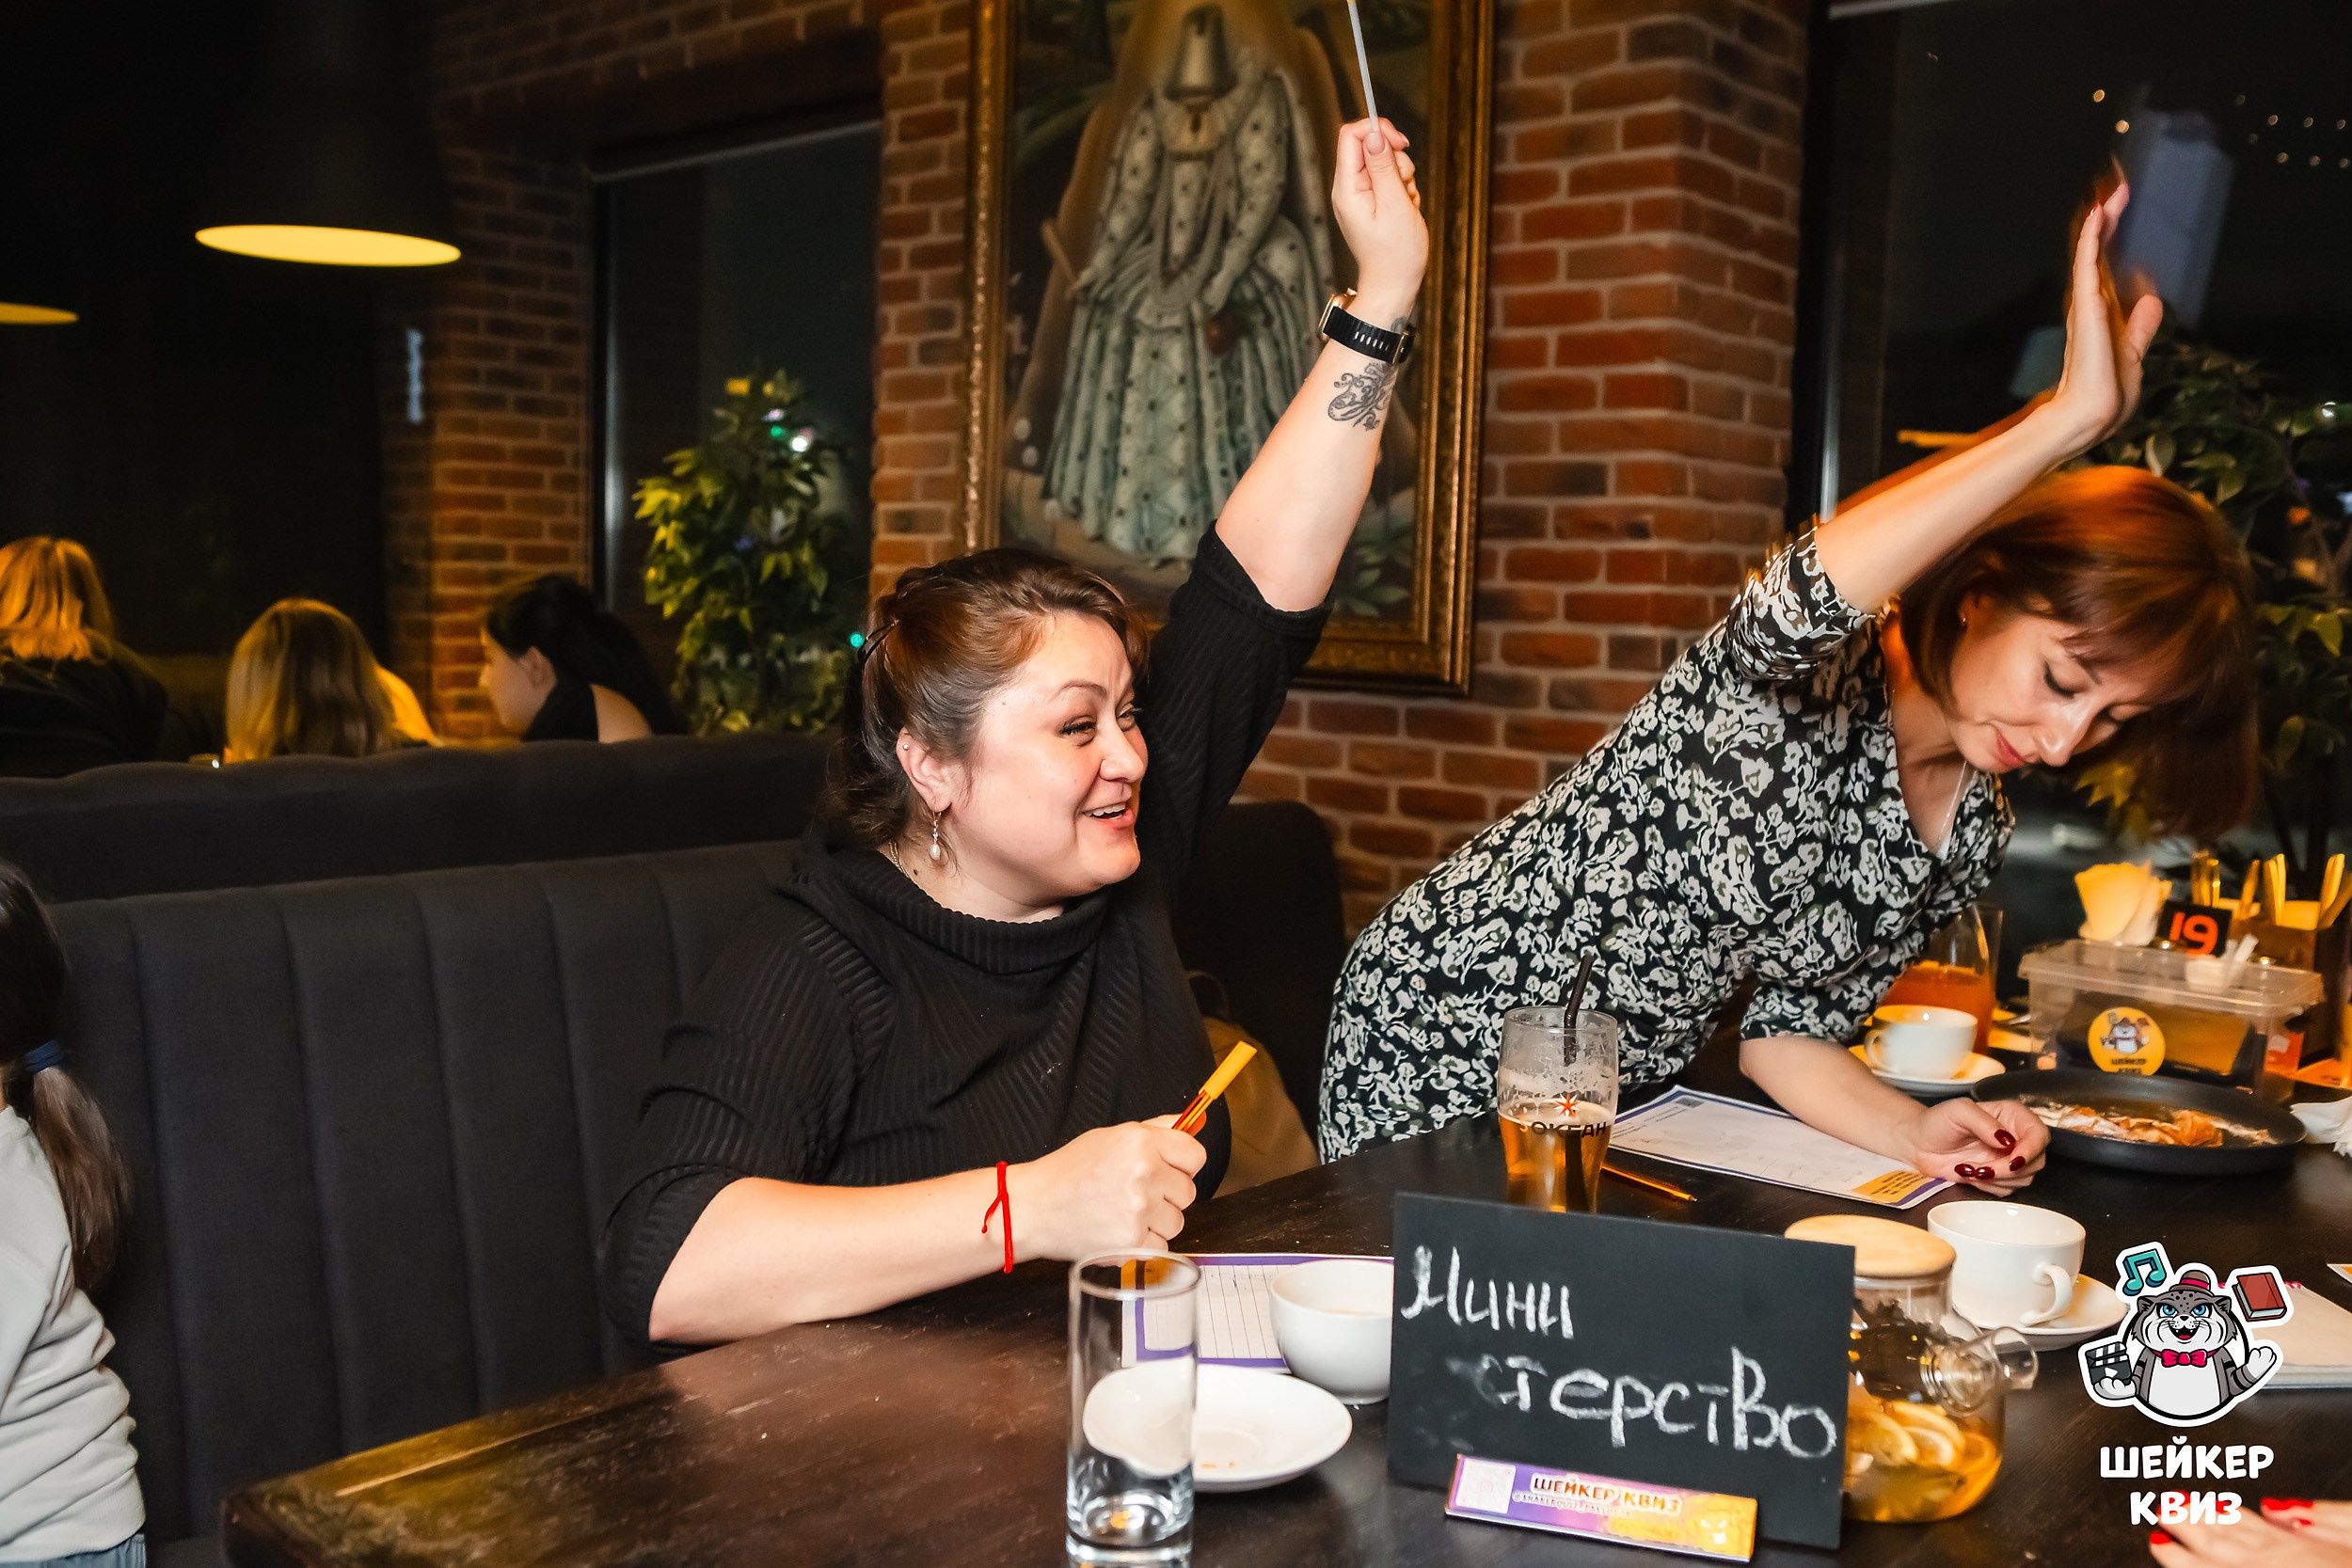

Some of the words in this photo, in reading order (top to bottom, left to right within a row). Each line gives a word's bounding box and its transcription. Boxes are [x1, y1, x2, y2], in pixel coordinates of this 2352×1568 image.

[2169, 911, 2218, 956] 19
[1534, 1474, 1615, 1501] ШЕЙКЕР
[1624, 1491, 1681, 1513] КВИЗ
